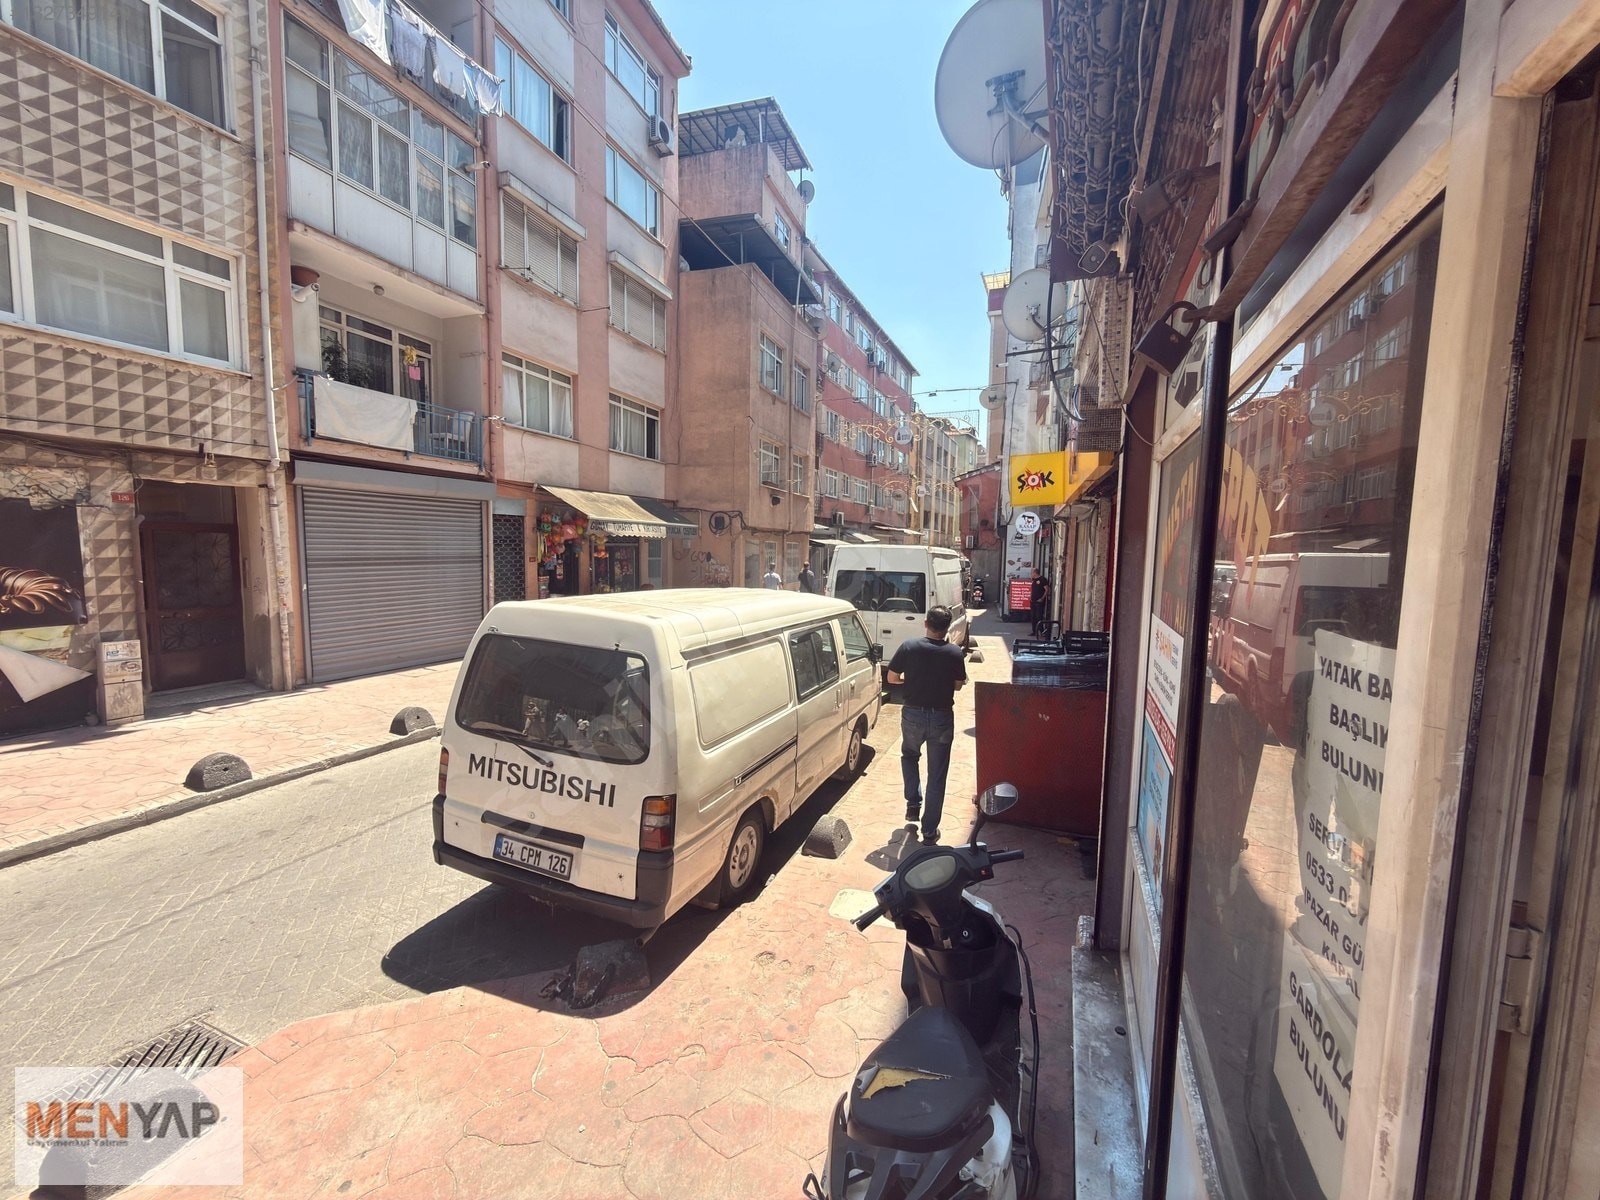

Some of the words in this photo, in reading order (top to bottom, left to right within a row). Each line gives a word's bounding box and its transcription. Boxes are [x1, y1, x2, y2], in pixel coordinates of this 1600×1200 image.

[1017, 470, 1055, 493] ŞOK
[1319, 655, 1362, 692] YATAK
[468, 753, 616, 808] MITSUBISHI
[502, 840, 514, 858] 34
[520, 846, 541, 867] CPM
[548, 854, 568, 874] 126
[1306, 850, 1334, 895] 0533
[1289, 1015, 1345, 1141] BULUNU
